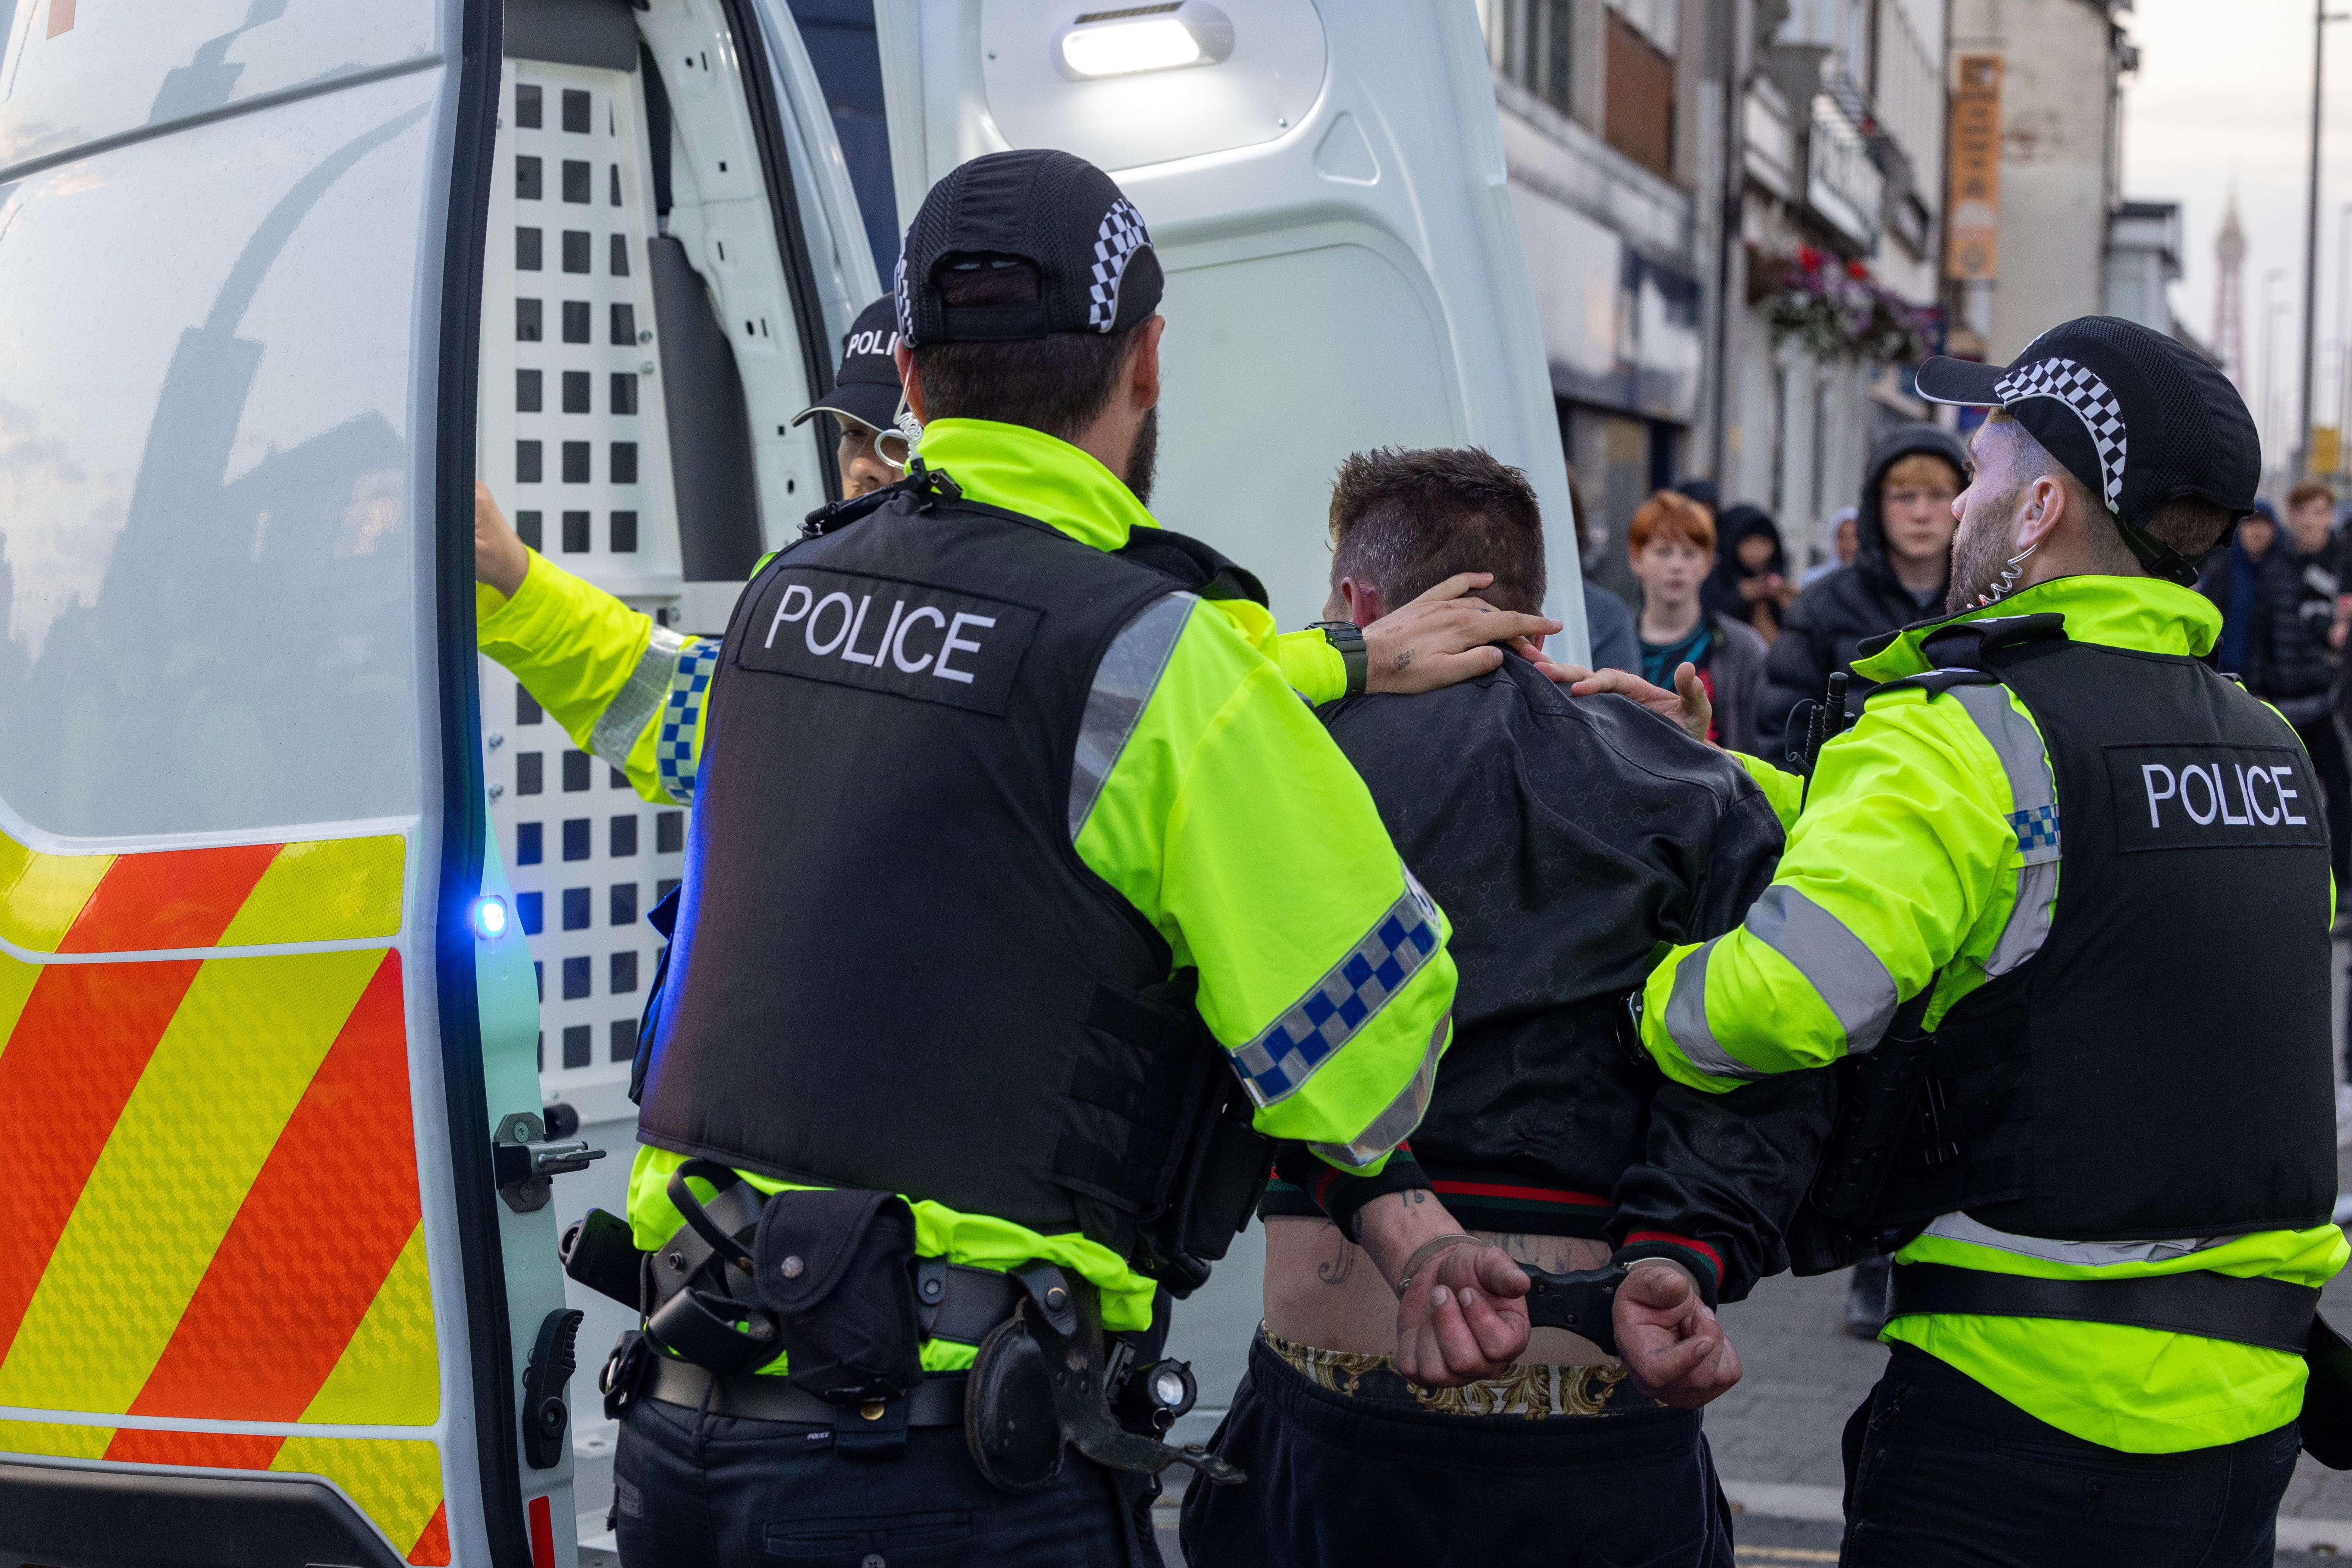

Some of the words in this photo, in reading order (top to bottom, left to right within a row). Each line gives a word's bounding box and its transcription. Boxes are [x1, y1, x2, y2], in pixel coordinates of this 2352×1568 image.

[846, 330, 898, 358] POLI
[764, 584, 996, 683] POLICE
[2141, 763, 2307, 828] POLICE
